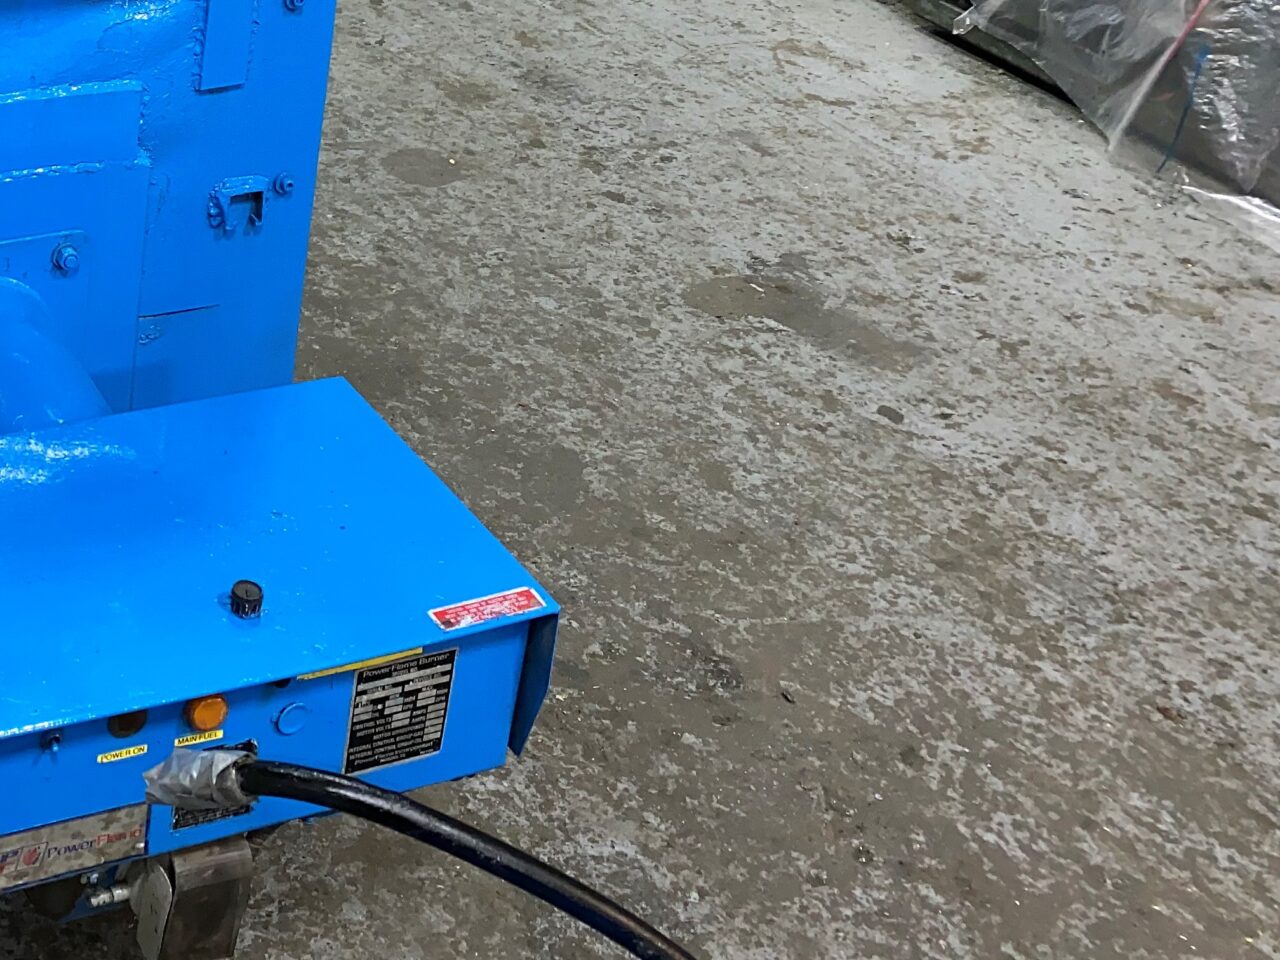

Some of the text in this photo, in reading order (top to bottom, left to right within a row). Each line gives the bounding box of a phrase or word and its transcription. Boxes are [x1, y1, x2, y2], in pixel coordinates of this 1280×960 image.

[177, 730, 219, 745] MAIN FUEL
[99, 745, 146, 763] POWER ON
